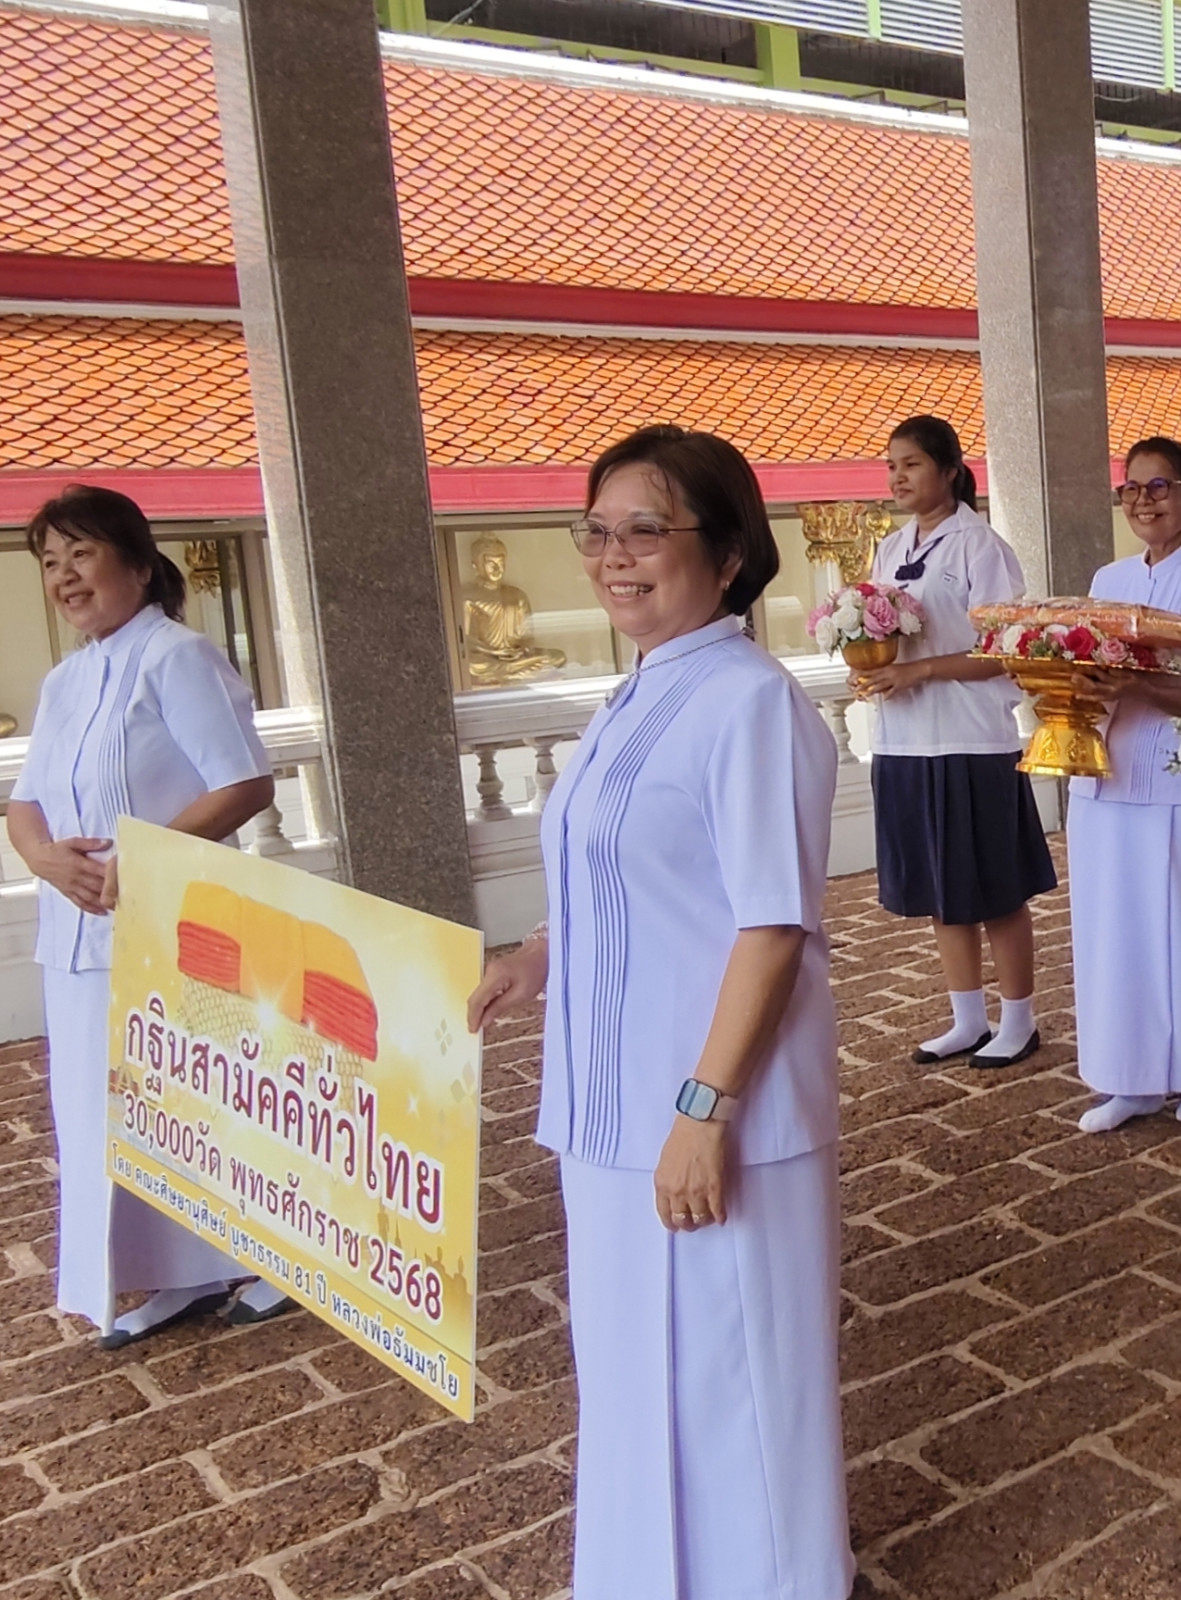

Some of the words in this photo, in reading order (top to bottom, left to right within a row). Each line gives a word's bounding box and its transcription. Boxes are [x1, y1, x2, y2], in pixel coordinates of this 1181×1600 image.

[125, 1094, 222, 1181] 30,000วัด
[230, 1157, 360, 1268] พุทธศักราช
[370, 1238, 441, 1320] 2568
[128, 997, 441, 1224] กฐินสามัคคีทั่วไทย
[112, 1143, 132, 1178] โดย
[230, 1226, 290, 1280] บูชาธรรม
[294, 1266, 312, 1296] 81
[316, 1274, 328, 1304] ปี
[331, 1292, 458, 1397] หลวงพ่อธัมมชโย
